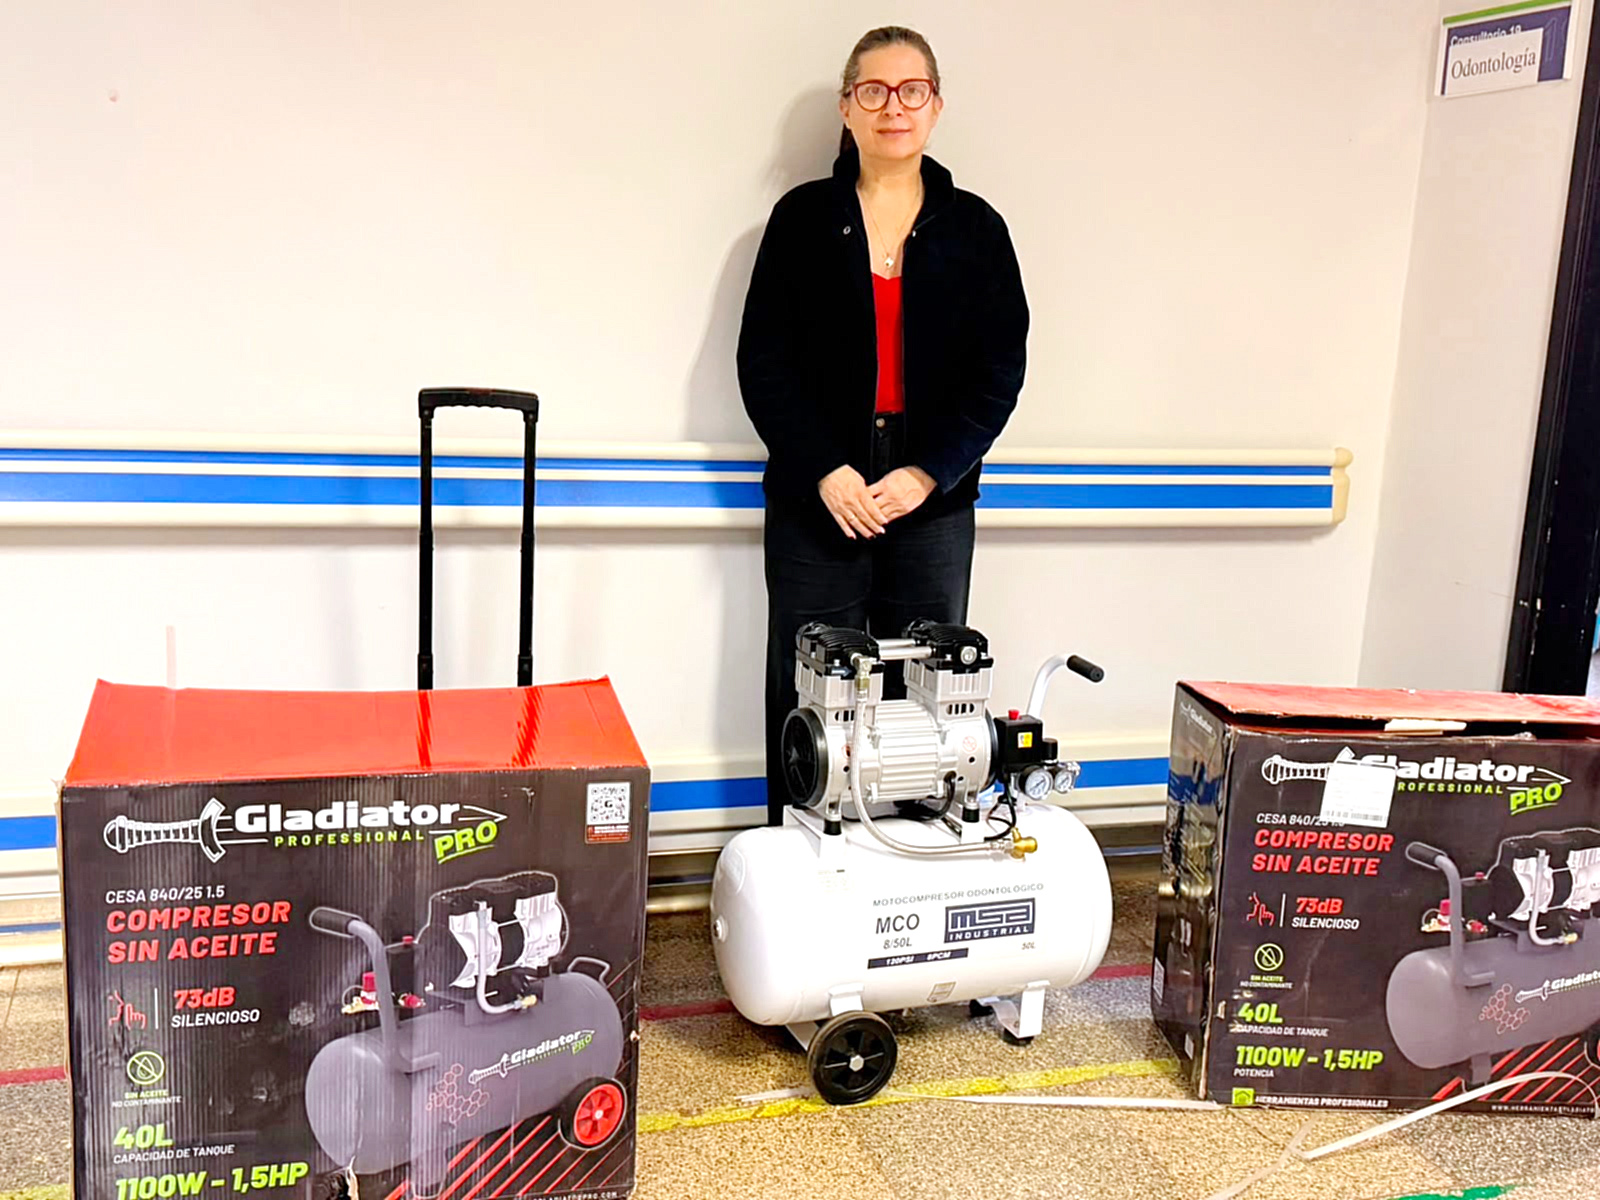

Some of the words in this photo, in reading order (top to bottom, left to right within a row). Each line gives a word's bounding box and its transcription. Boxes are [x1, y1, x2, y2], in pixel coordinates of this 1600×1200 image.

[1451, 47, 1536, 79] Odontología
[1397, 782, 1504, 795] ROFESSIONAL
[1510, 782, 1562, 811] PRO
[234, 800, 460, 833] Gladiator
[1256, 813, 1287, 824] CESA
[274, 830, 425, 847] PROFESSIONAL
[434, 819, 498, 859] PRO
[1254, 828, 1394, 852] COMPRESOR
[1252, 853, 1292, 872] SIN
[1296, 856, 1381, 876] ACEITE
[105, 889, 147, 904] CESA
[150, 886, 203, 902] 840/25
[206, 885, 225, 898] 1.5
[872, 890, 964, 907] MOTOCOMPRESOR
[1295, 897, 1343, 914] 73dB
[106, 901, 291, 932] COMPRESOR
[875, 913, 920, 934] MCO
[1291, 916, 1360, 930] SILENCIOSO
[883, 937, 912, 950] 8/50L
[949, 926, 1029, 941] INDUSTRIAL
[107, 938, 159, 964] SIN
[168, 932, 278, 961] ACEITE
[173, 986, 236, 1010] 73dB
[171, 1009, 261, 1028] SILENCIOSO
[1238, 1002, 1283, 1024] 40L
[1284, 1027, 1294, 1035] DE
[1296, 1028, 1329, 1037] TANQUE
[511, 1030, 581, 1064] Gladiator
[1236, 1045, 1306, 1067] 1100W
[1323, 1049, 1384, 1071] 1,5HP
[1233, 1068, 1274, 1078] POTENCIA
[1255, 1095, 1320, 1106] HERRAMIENTAS
[1320, 1097, 1389, 1108] PROFESIONALES
[113, 1123, 173, 1150] 40L
[113, 1149, 174, 1165] CAPACIDAD
[176, 1148, 190, 1159] DE
[192, 1144, 236, 1158] TANQUE
[115, 1171, 207, 1200] 1100W
[231, 1161, 310, 1194] 1,5HP
